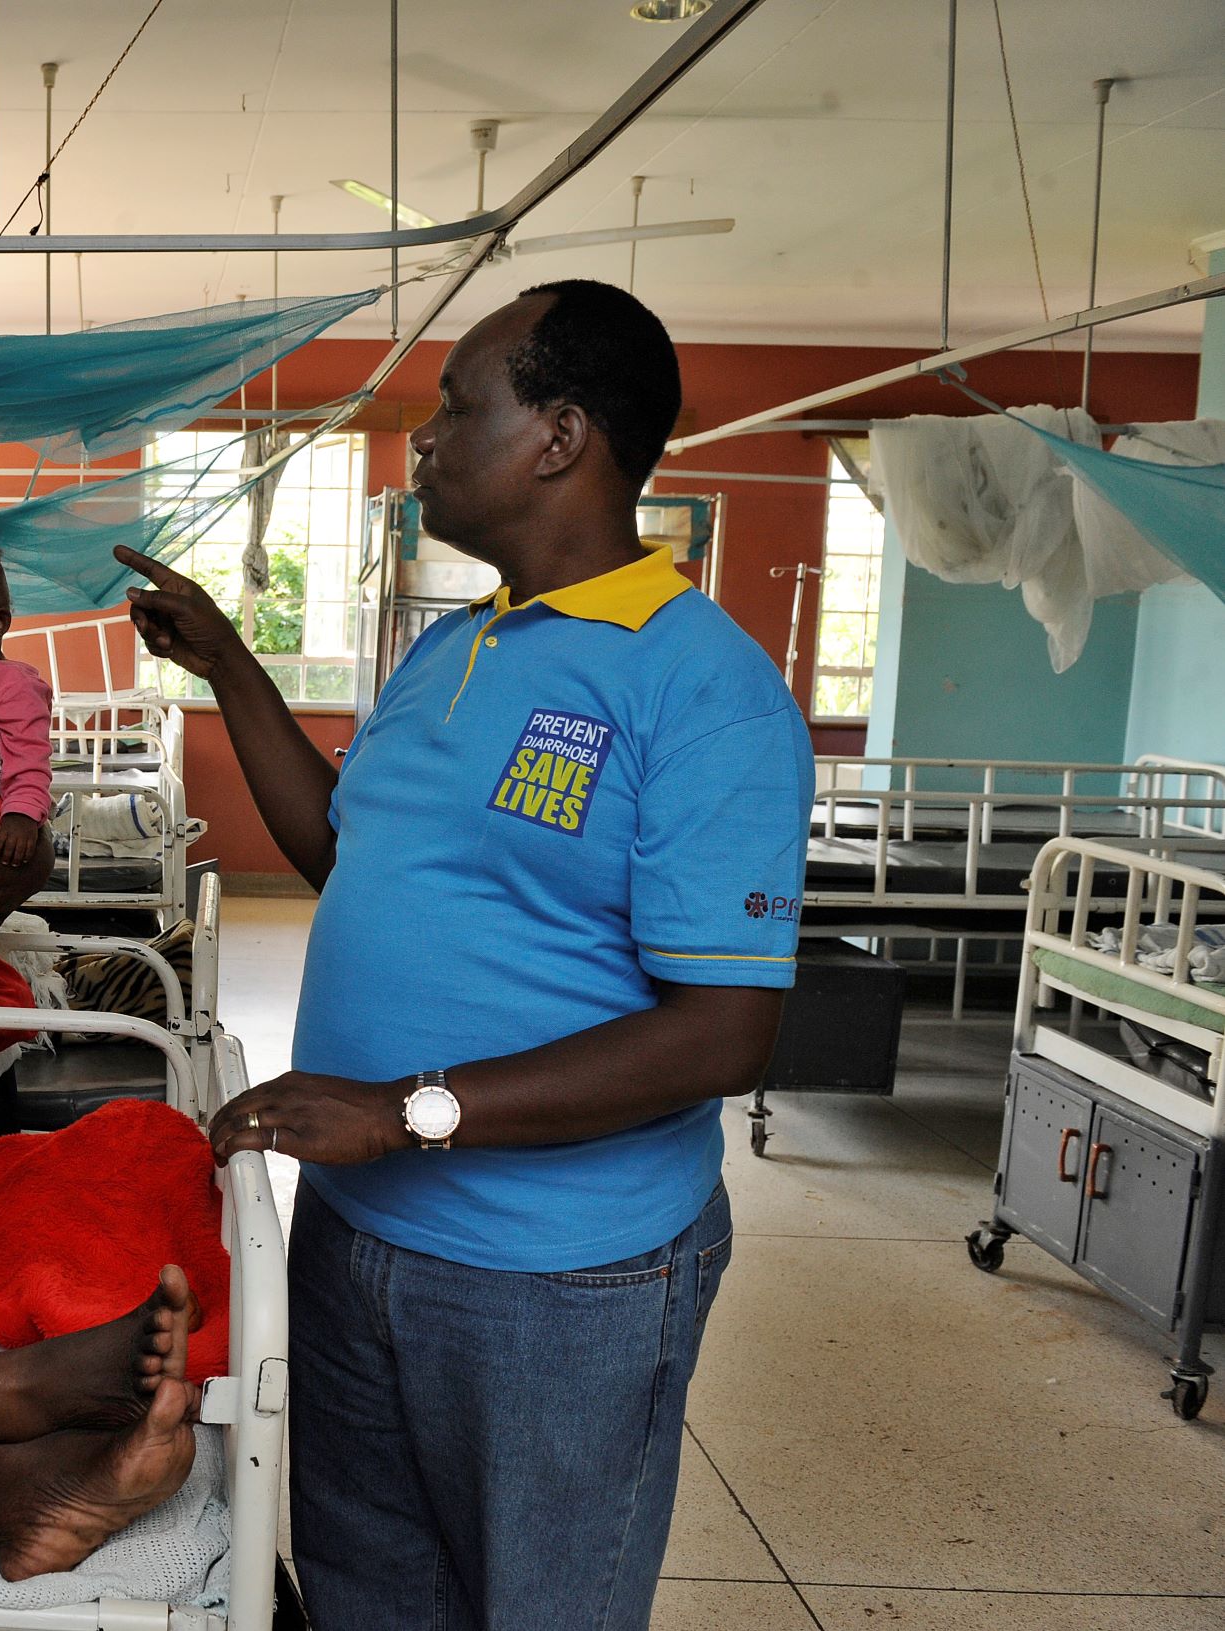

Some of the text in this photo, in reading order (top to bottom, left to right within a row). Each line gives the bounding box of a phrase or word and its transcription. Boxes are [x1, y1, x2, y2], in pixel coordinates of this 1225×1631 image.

[522, 734, 599, 768] DIARRHOEA
[529, 713, 609, 748] PREVENT
[509, 748, 595, 799] SAVE
[494, 777, 583, 830] LIVES
